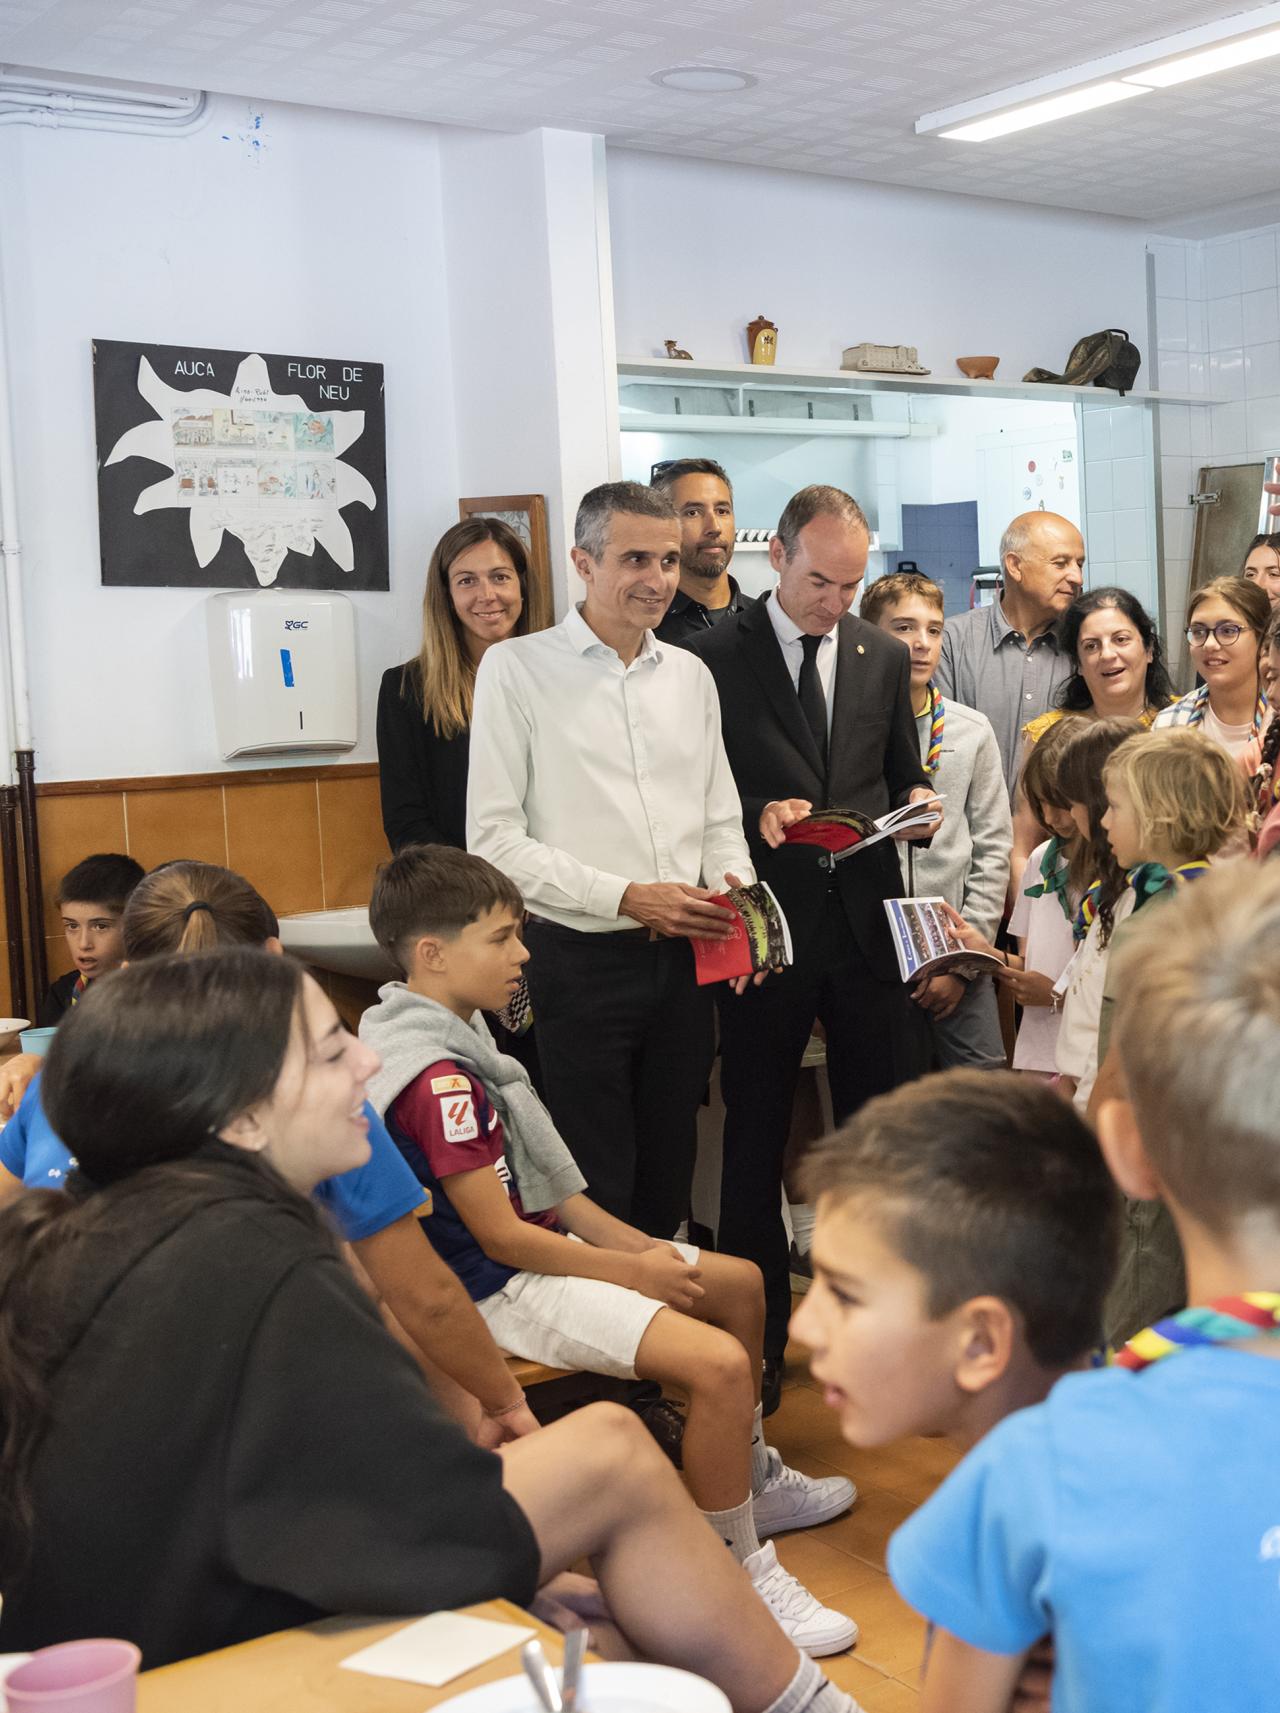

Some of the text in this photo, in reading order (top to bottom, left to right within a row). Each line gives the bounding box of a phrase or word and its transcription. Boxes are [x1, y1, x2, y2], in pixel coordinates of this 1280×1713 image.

[174, 360, 363, 382] AUCA FLOR DE
[319, 385, 350, 401] NEU
[449, 1126, 475, 1136] LALIGA
